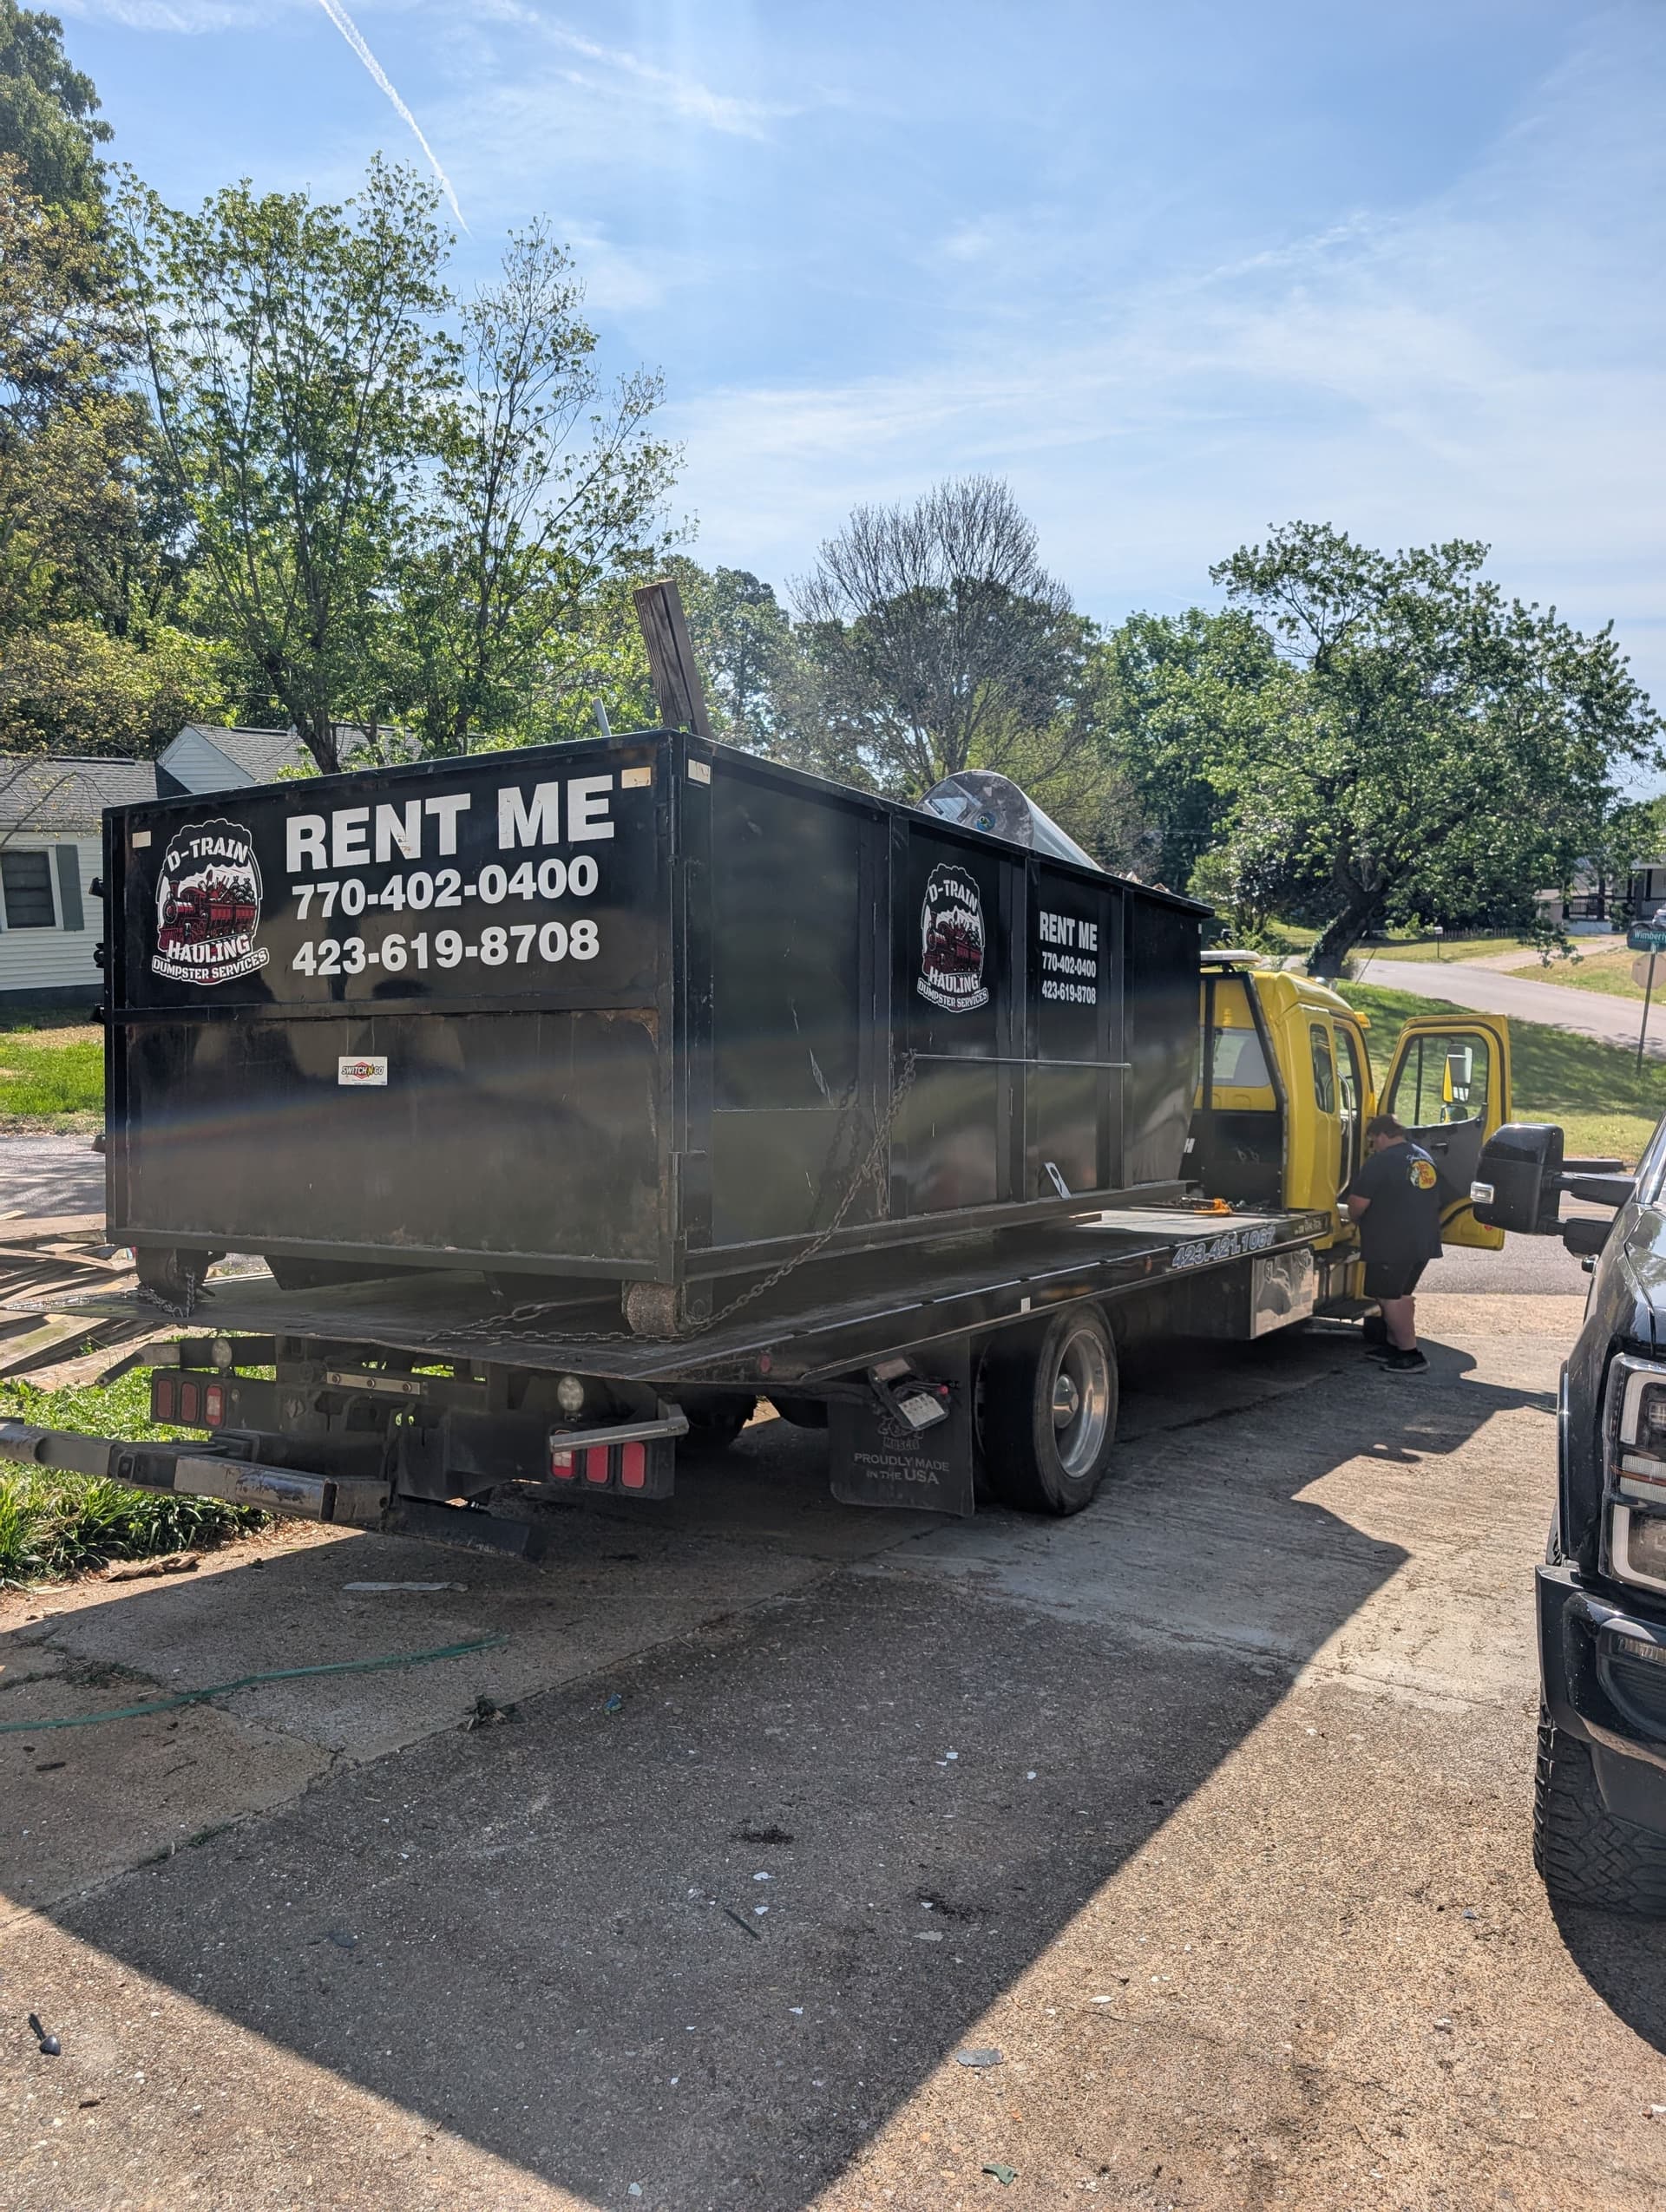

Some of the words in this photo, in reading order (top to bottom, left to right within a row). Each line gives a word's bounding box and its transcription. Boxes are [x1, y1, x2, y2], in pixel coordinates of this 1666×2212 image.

[285, 792, 471, 873] RENT
[498, 775, 614, 849] ME
[167, 836, 249, 873] D-TRAIN
[292, 854, 599, 919] 770-402-0400
[928, 880, 978, 912] D-TRAIN
[1040, 910, 1075, 946] RENT
[1079, 920, 1098, 952] ME
[167, 934, 251, 963] HAULING
[292, 919, 600, 977] 423-619-8708
[153, 959, 209, 979] DUMPSTER
[212, 951, 267, 978] SERVICES
[1041, 951, 1097, 978] 770-402-0400
[929, 966, 980, 993] HAULING
[1041, 980, 1097, 1005] 423-619-8708
[917, 982, 956, 1007] DUMPSTER
[957, 988, 987, 1008] SERVICES
[341, 1065, 367, 1076] SWITCH
[854, 1452, 911, 1467] PROUDLY
[915, 1456, 950, 1472] MADE
[866, 1470, 878, 1479] IN
[880, 1470, 902, 1480] THE
[904, 1468, 940, 1485] USA
